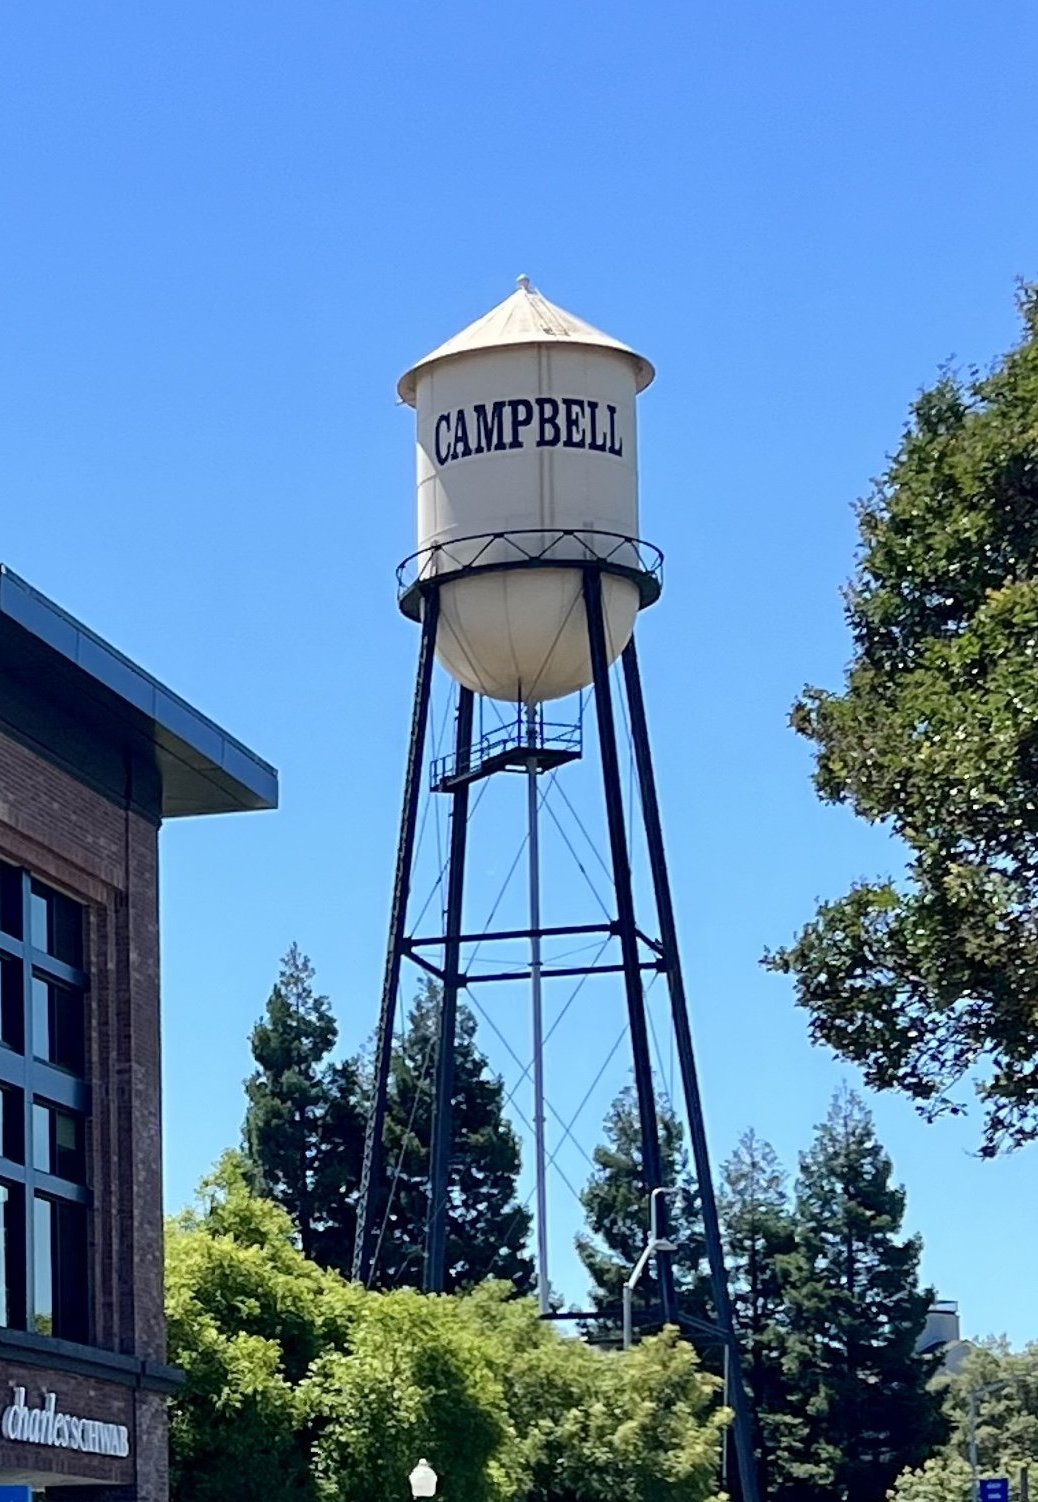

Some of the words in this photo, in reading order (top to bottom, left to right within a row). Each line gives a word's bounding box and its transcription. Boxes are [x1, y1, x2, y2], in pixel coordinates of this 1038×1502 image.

[435, 397, 623, 466] CAMPBELL
[2, 1386, 70, 1448] charles
[70, 1416, 130, 1457] SCHWAB
